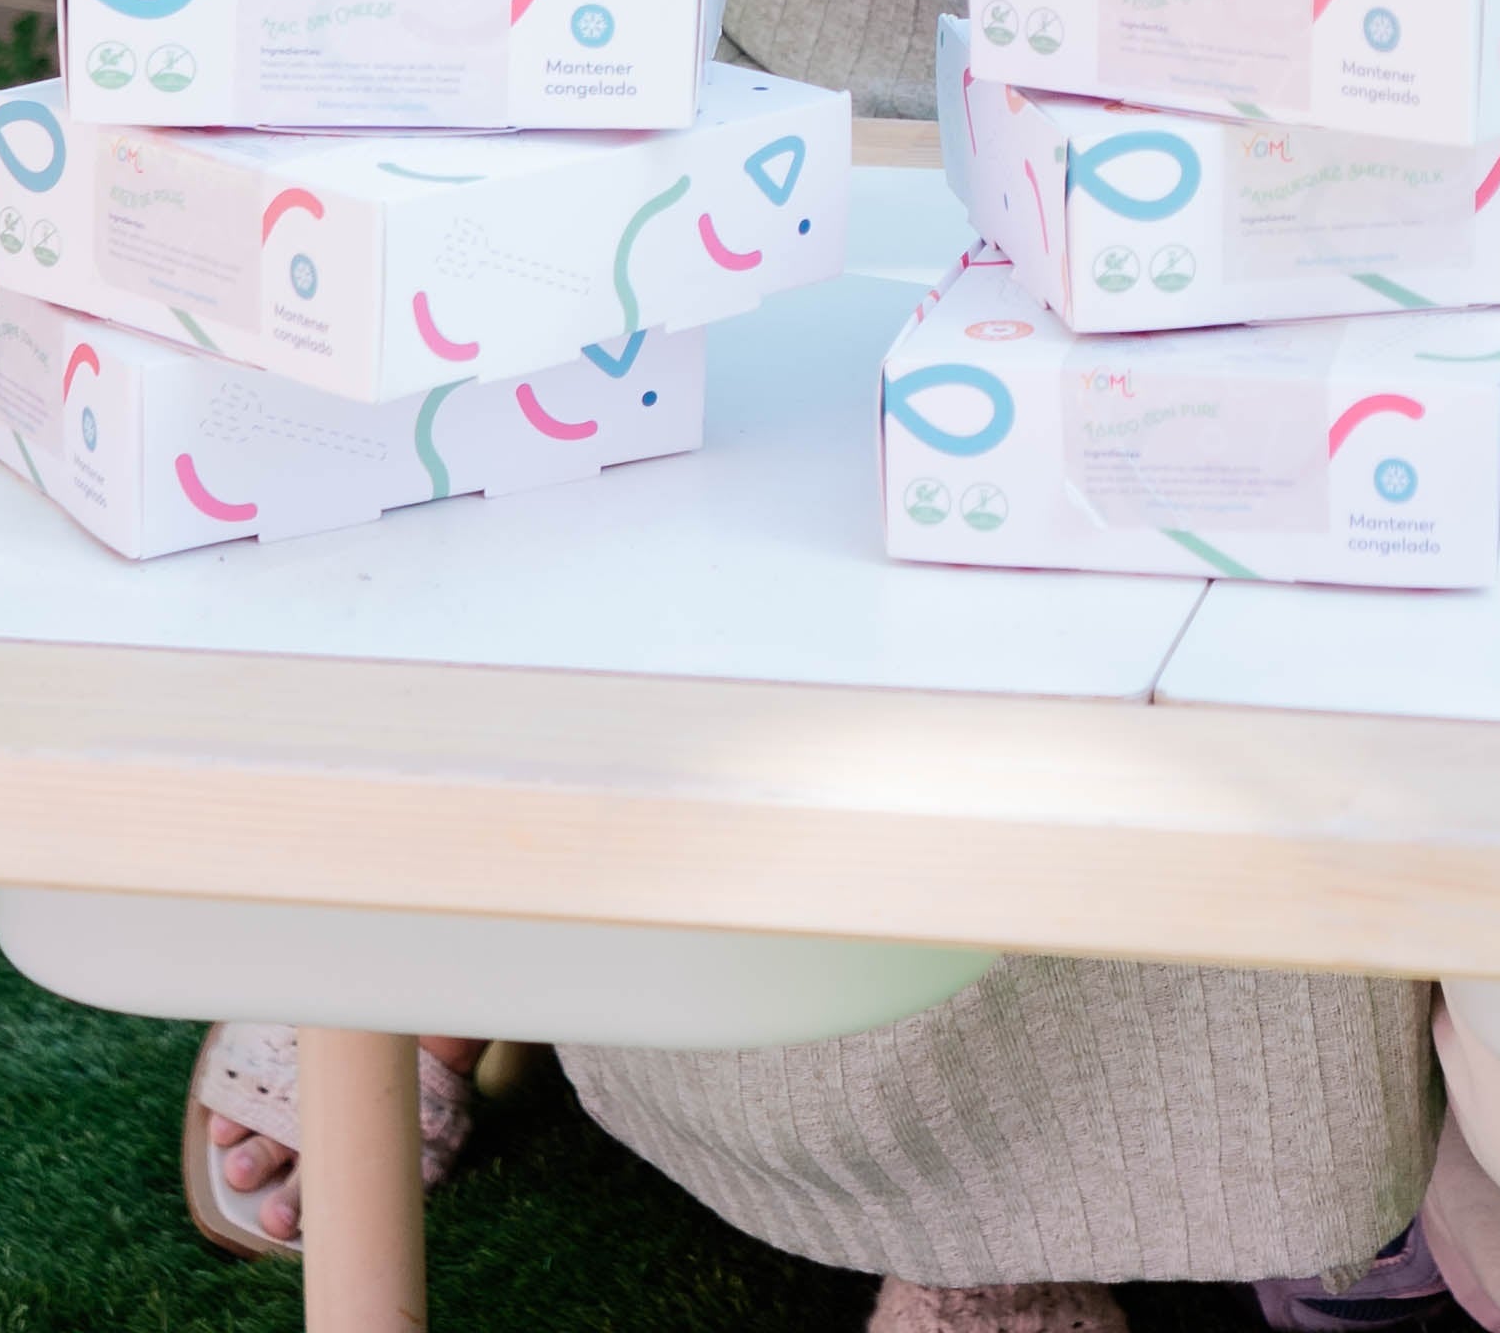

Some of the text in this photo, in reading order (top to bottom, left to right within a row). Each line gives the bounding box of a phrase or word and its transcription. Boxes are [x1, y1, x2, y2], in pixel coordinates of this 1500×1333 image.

[546, 59, 634, 75] Mantener
[1342, 59, 1416, 84] Mantener
[544, 79, 638, 99] congelado
[1341, 85, 1421, 106] congelado
[274, 302, 329, 333] Mantener
[273, 327, 333, 357] congelado
[1349, 513, 1435, 533] Mantener
[1348, 536, 1441, 555] congelado
